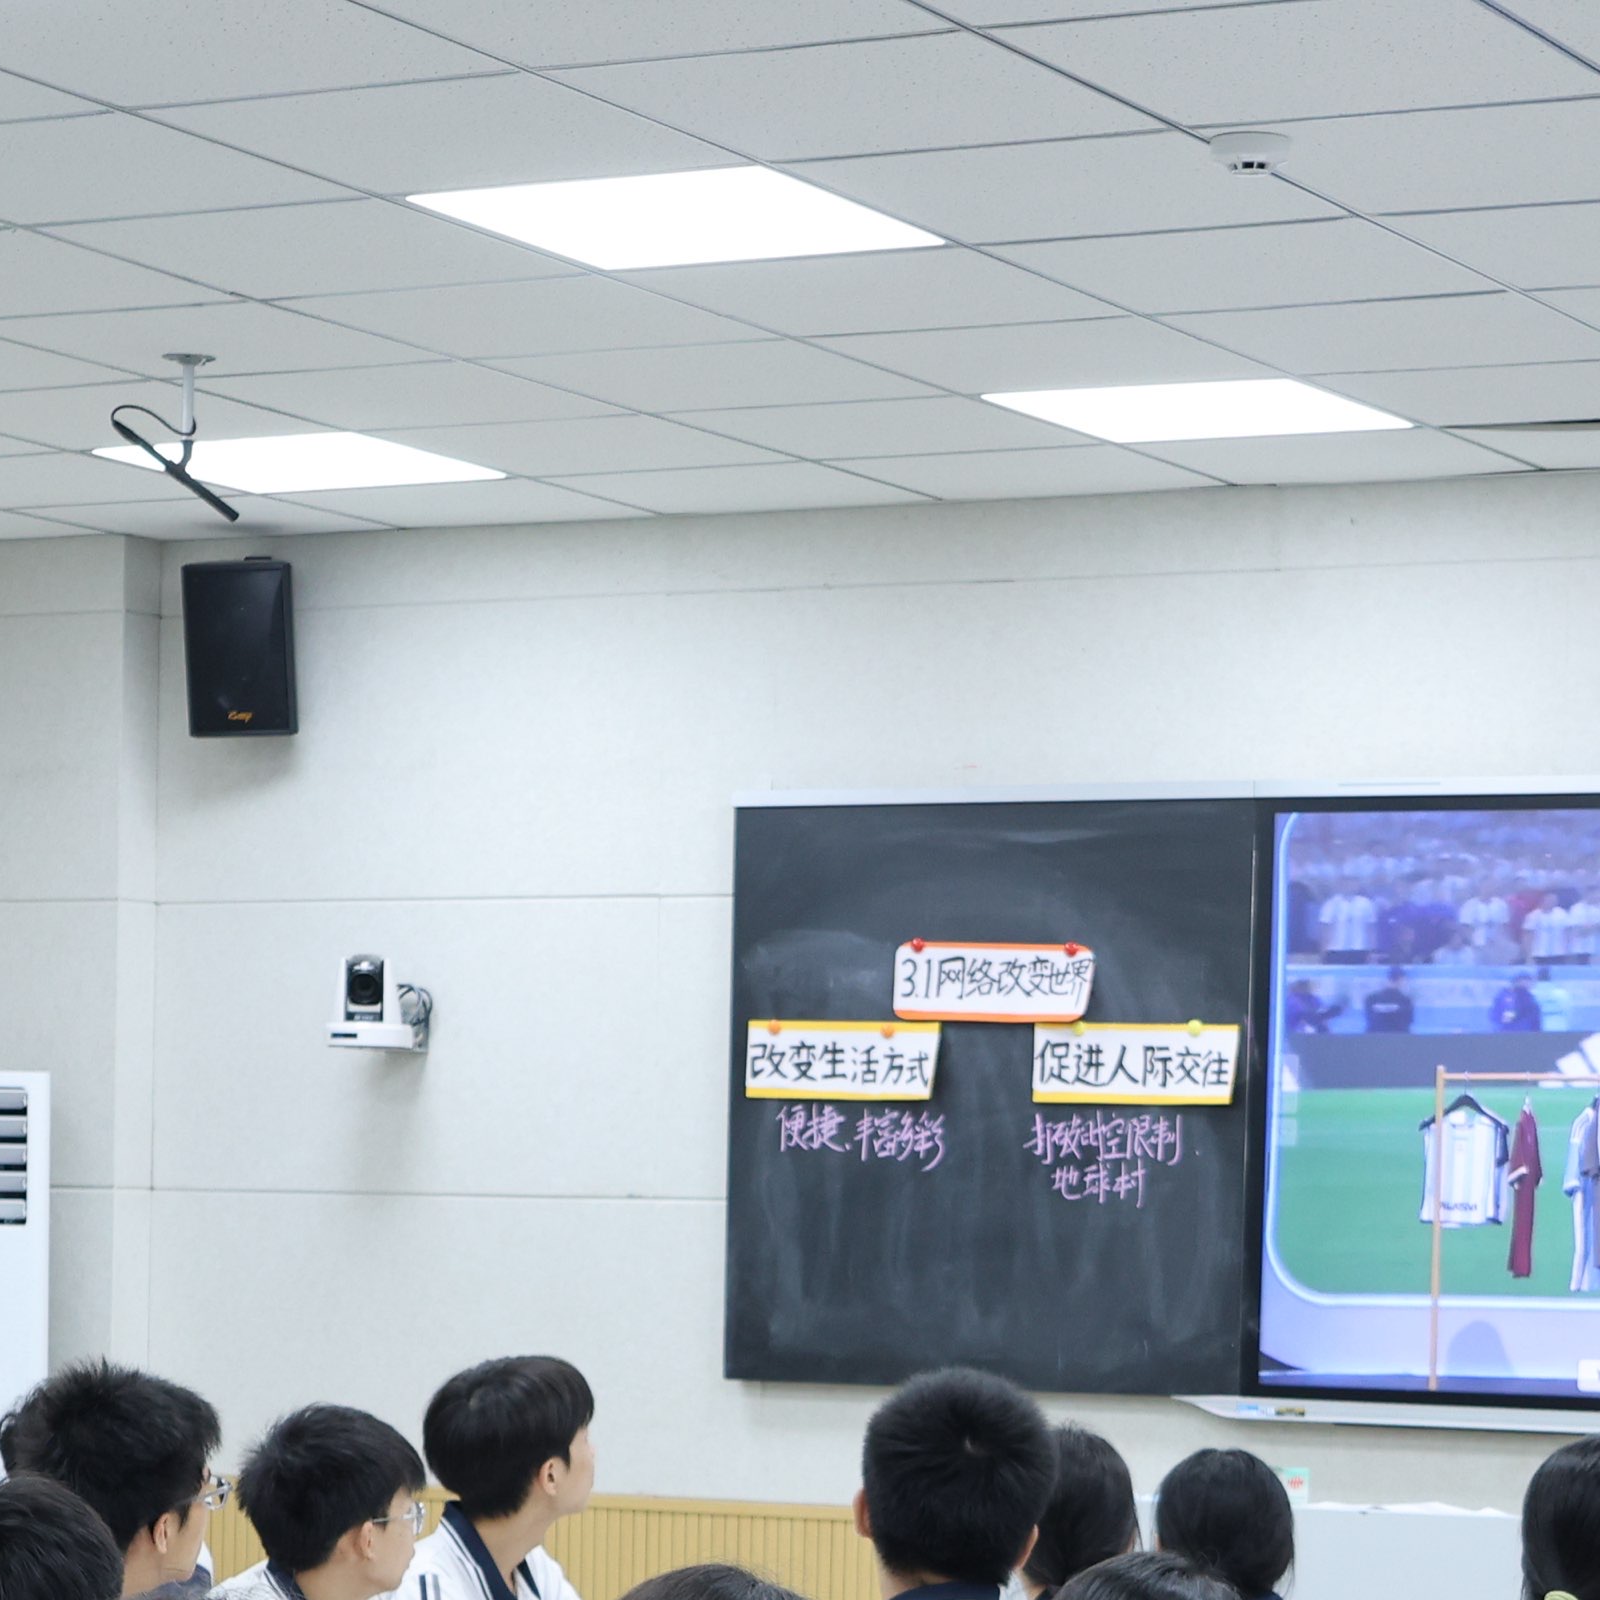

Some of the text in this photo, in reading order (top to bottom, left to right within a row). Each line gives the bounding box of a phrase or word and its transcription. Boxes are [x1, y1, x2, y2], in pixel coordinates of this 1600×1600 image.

[901, 955, 1094, 1009] 3.1网络改变世界
[749, 1040, 930, 1088] 改变生活方式
[1033, 1038, 1230, 1088] 促进人际交往
[1051, 1157, 1146, 1209] 地球村
